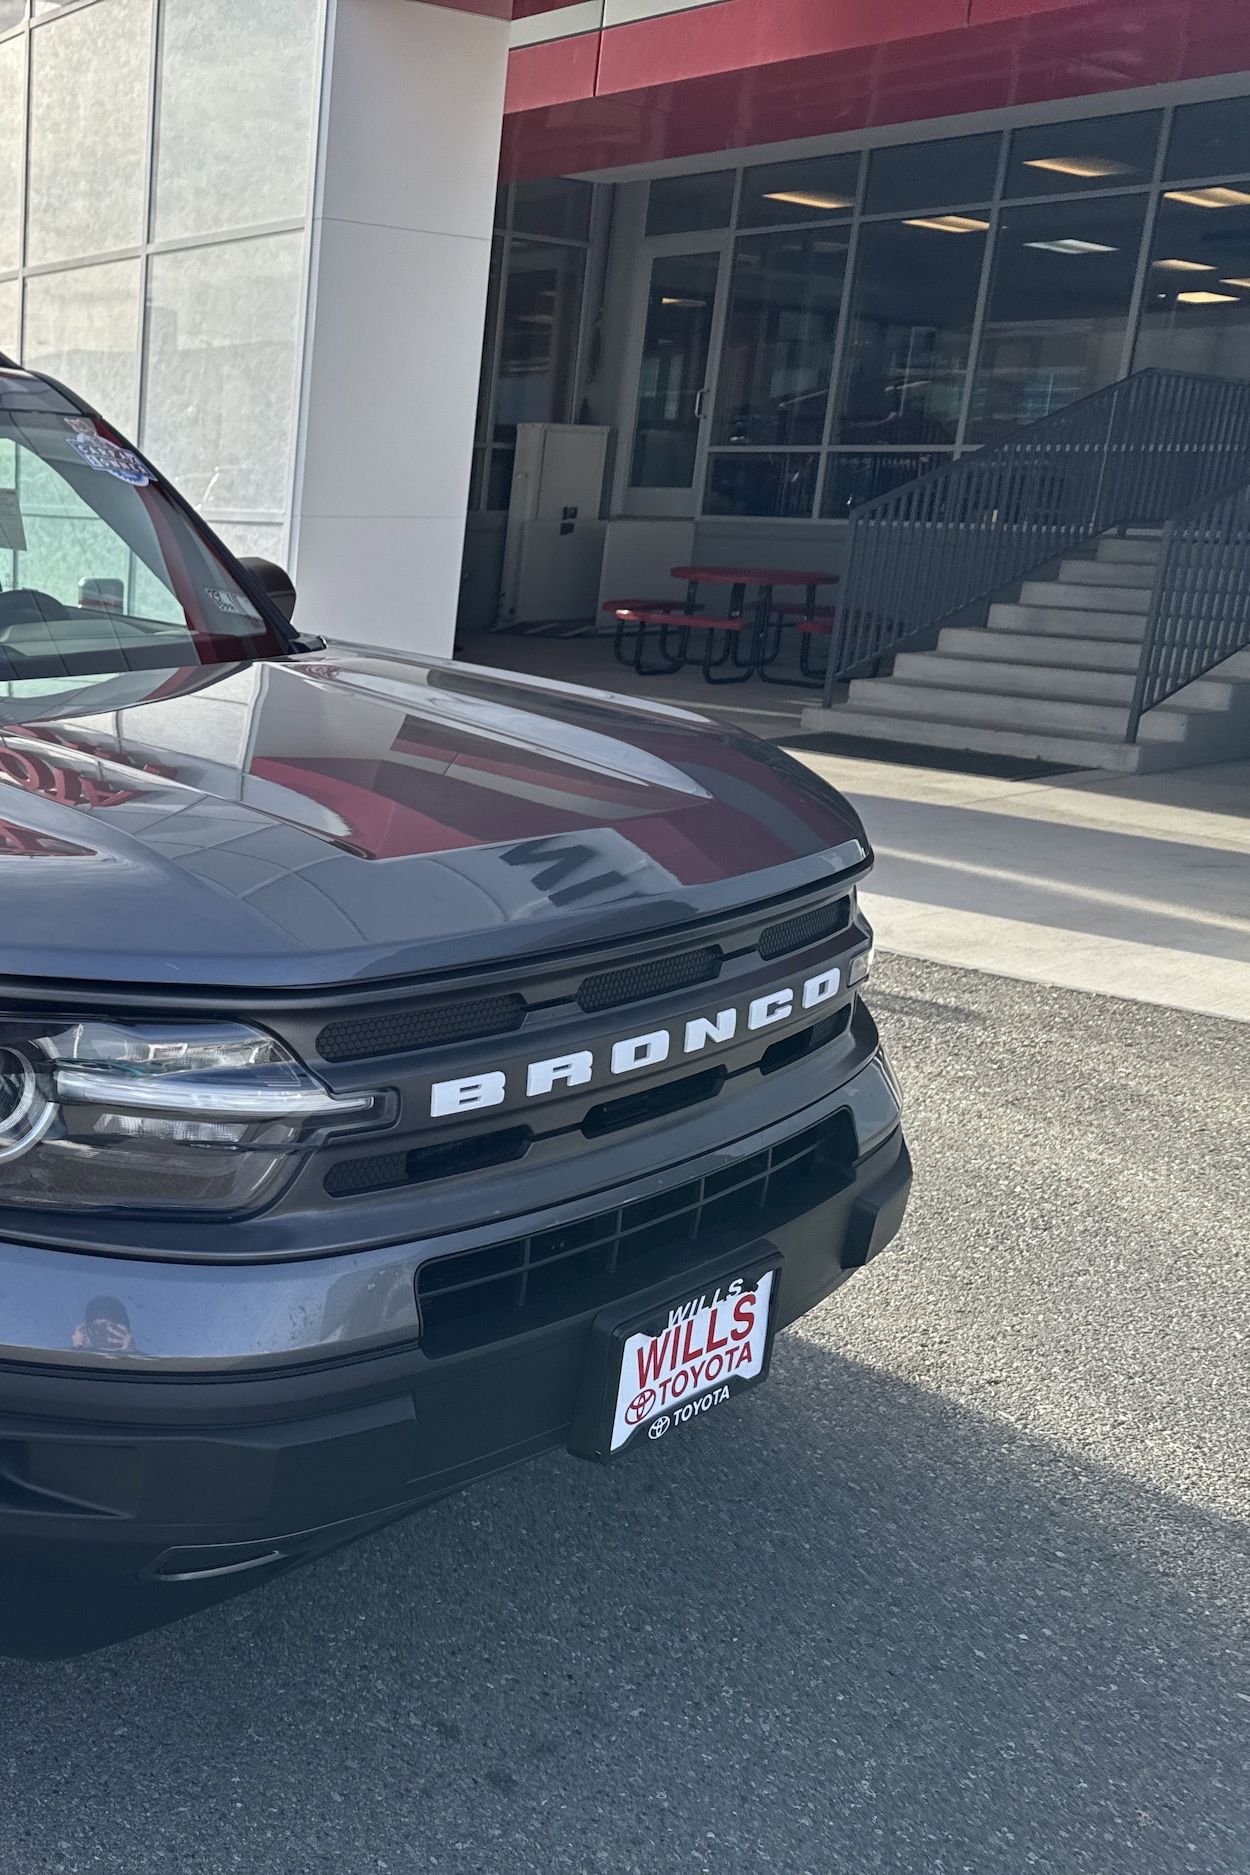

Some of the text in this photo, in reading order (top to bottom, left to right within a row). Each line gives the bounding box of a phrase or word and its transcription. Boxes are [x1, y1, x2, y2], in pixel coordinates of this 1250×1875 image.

[430, 967, 841, 1118] BRONCO
[667, 1278, 744, 1328] WILLS
[637, 1293, 756, 1390] WILLS
[659, 1341, 753, 1405] TOYOTA
[673, 1385, 730, 1427] TOYOTA
